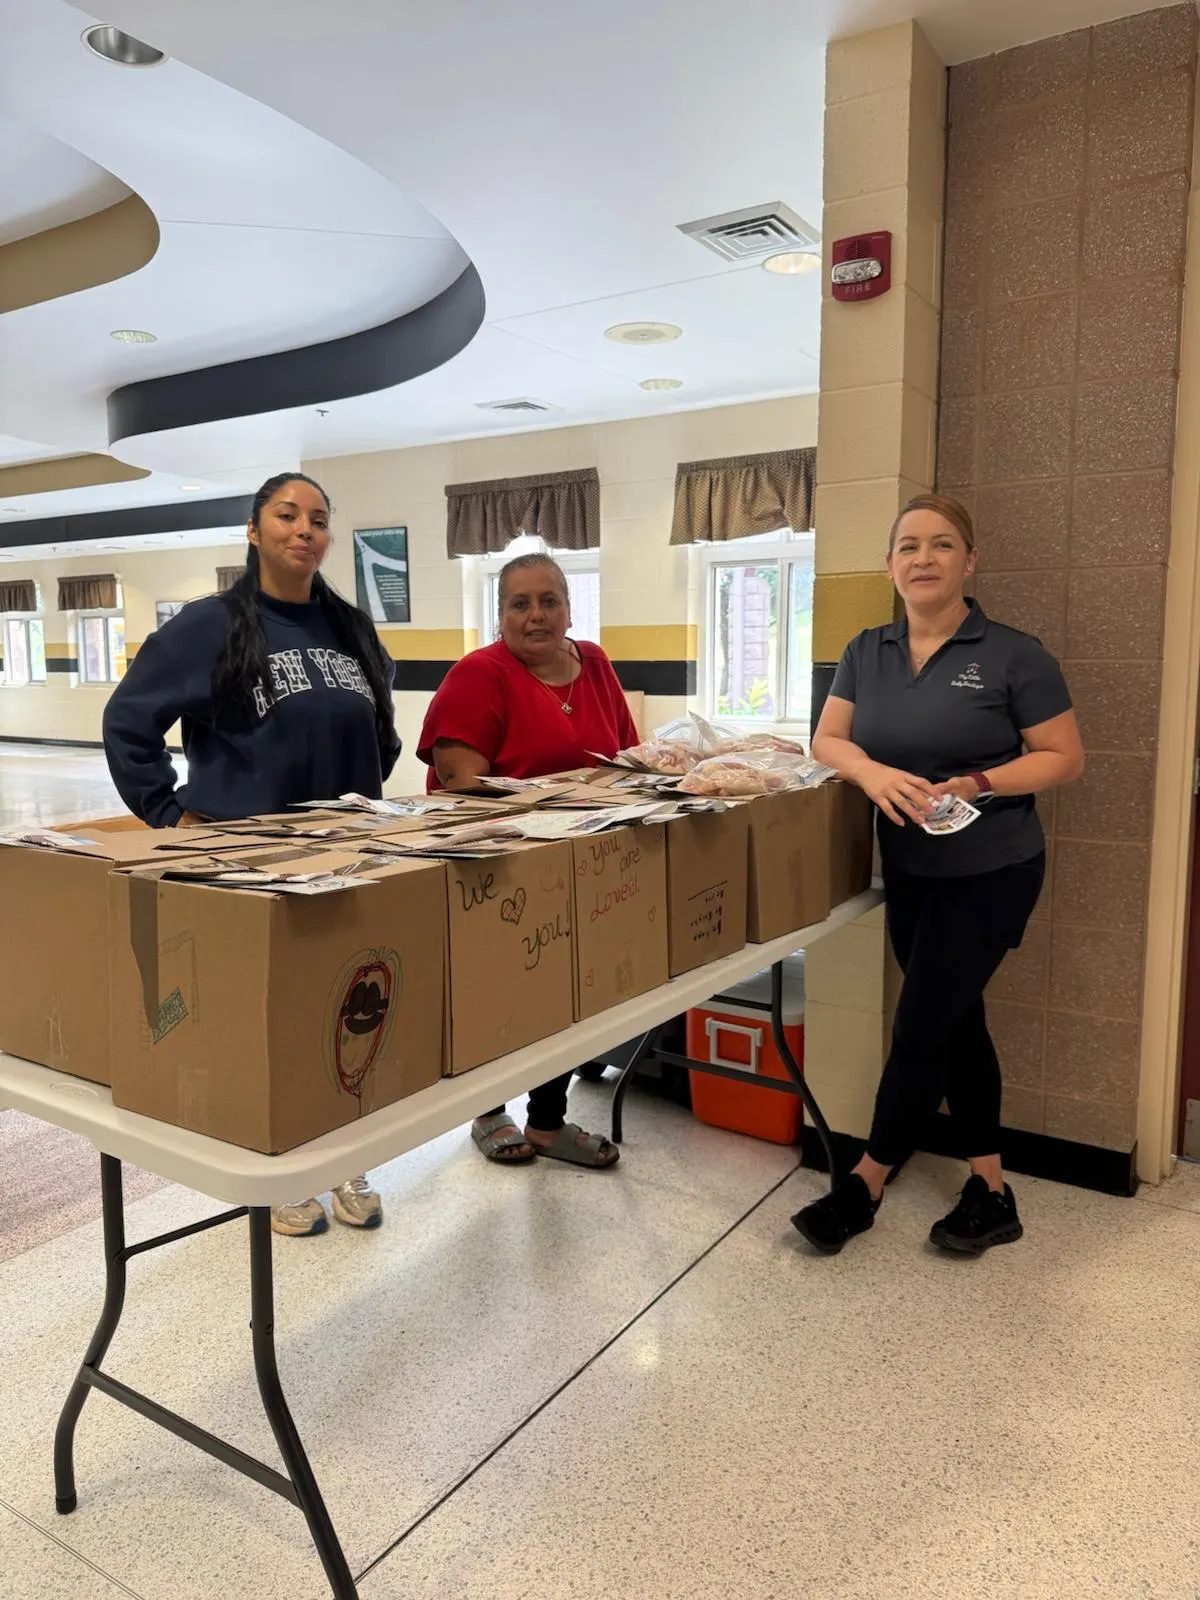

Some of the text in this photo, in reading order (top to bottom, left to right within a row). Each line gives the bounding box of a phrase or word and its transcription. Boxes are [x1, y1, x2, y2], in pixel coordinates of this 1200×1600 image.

[845, 282, 871, 294] FIRE
[620, 848, 641, 873] are
[456, 872, 500, 912] We
[521, 900, 571, 971] you!
